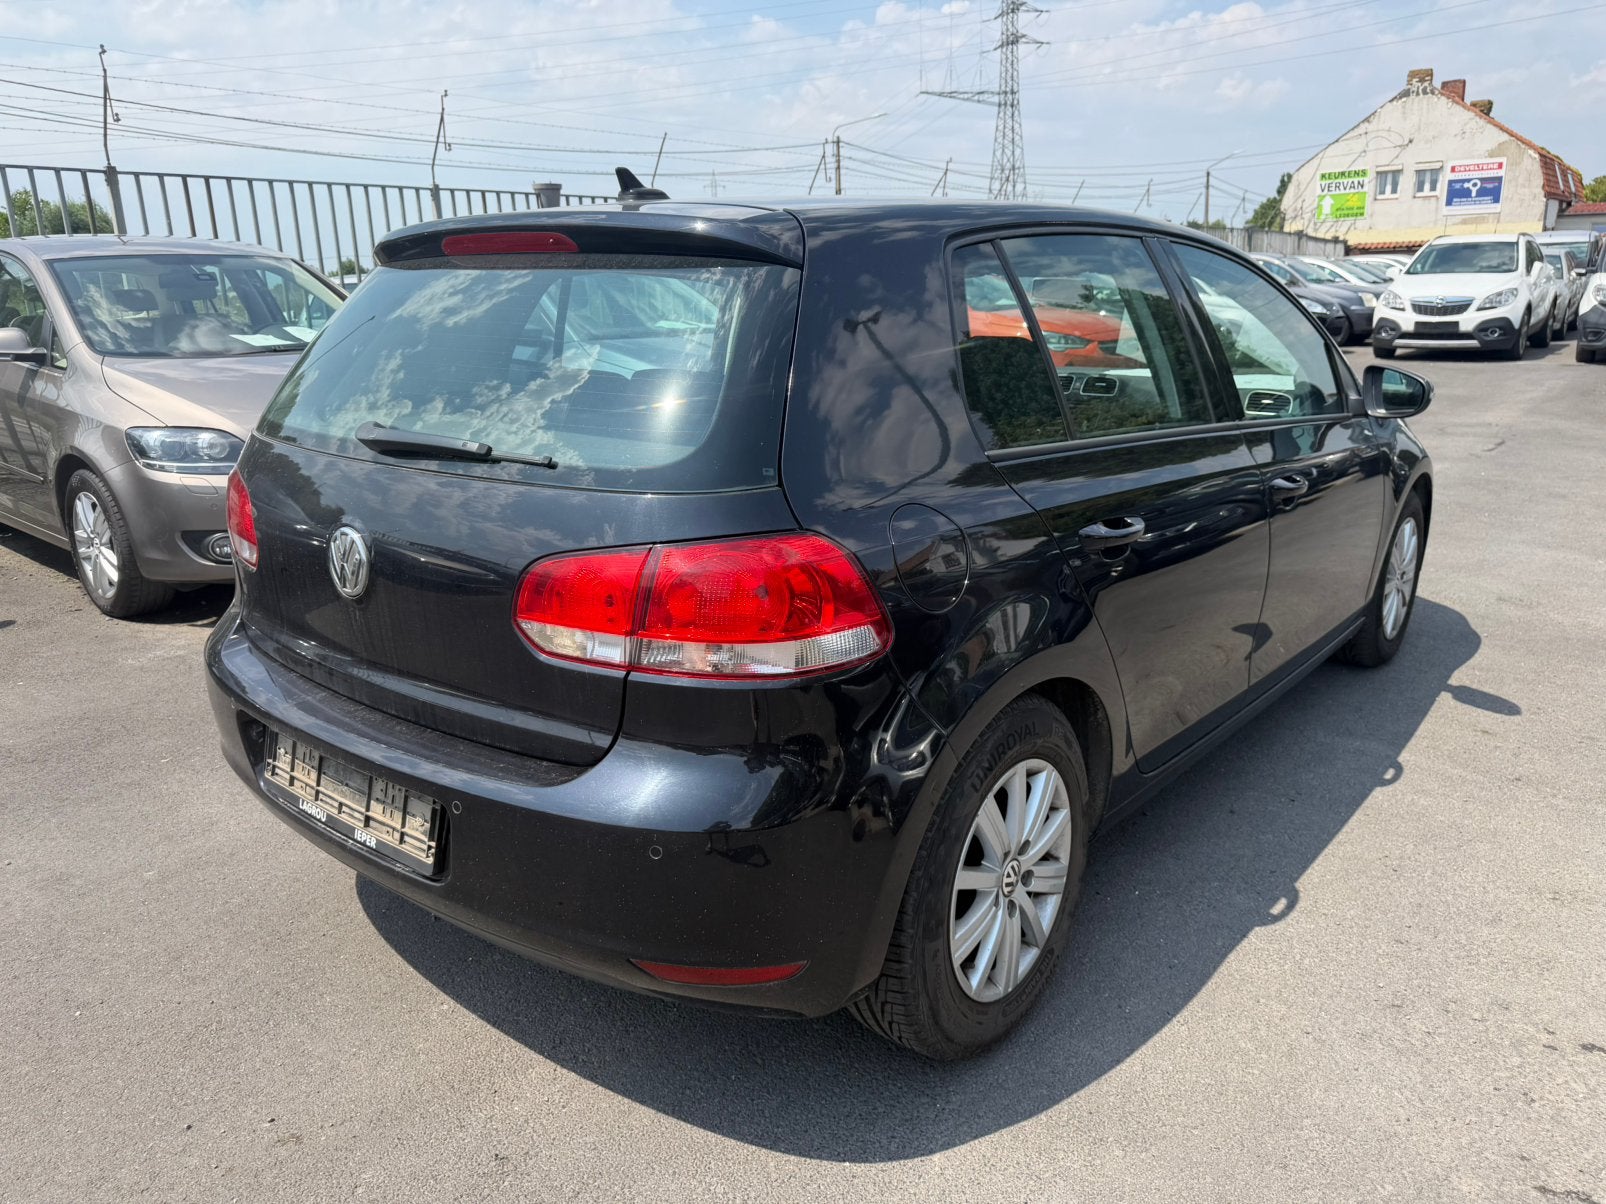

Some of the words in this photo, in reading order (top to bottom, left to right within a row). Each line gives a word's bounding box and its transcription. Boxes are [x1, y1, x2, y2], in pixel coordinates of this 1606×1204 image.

[1454, 162, 1499, 172] DEVELTERE
[1320, 169, 1367, 181] KEUKENS
[1319, 180, 1365, 192] VERVAN
[970, 720, 1040, 793] UNIROYAL
[299, 798, 327, 822] LAGROU
[354, 828, 377, 849] IEPER
